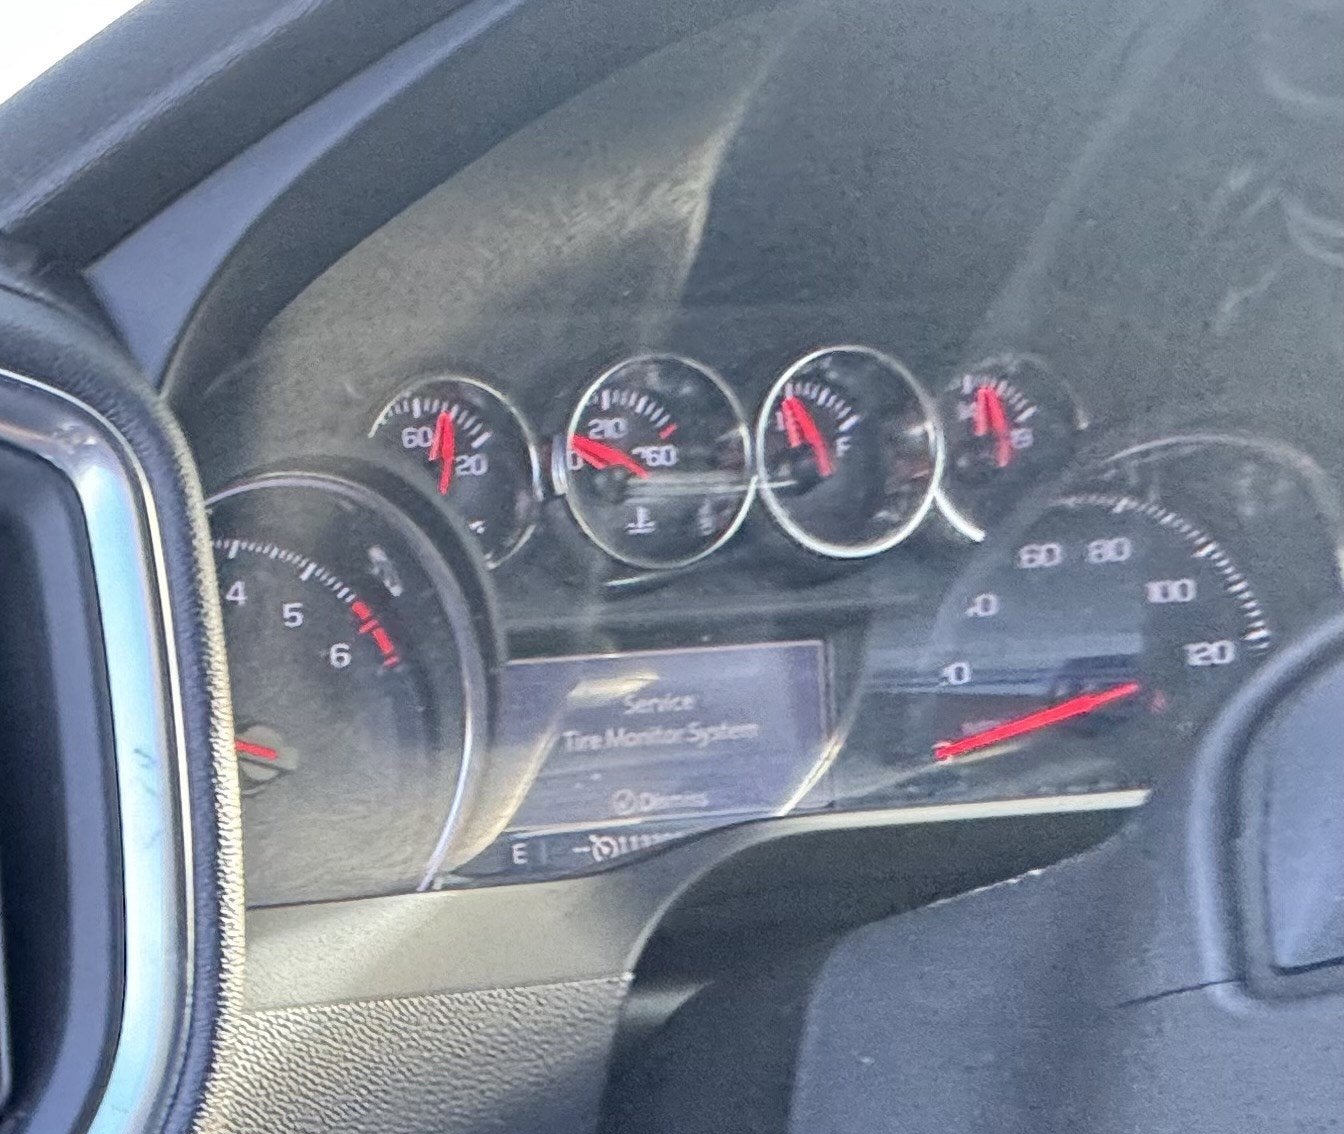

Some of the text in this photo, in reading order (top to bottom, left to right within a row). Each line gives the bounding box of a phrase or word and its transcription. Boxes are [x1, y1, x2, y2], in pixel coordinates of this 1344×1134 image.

[1085, 537, 1133, 564] 80
[226, 581, 248, 606] 4
[964, 593, 1000, 618] 0
[282, 602, 305, 628] 5
[329, 642, 352, 669] 6
[623, 693, 696, 715] Service
[563, 721, 760, 752] Tire Monitor System
[511, 842, 529, 865] E
